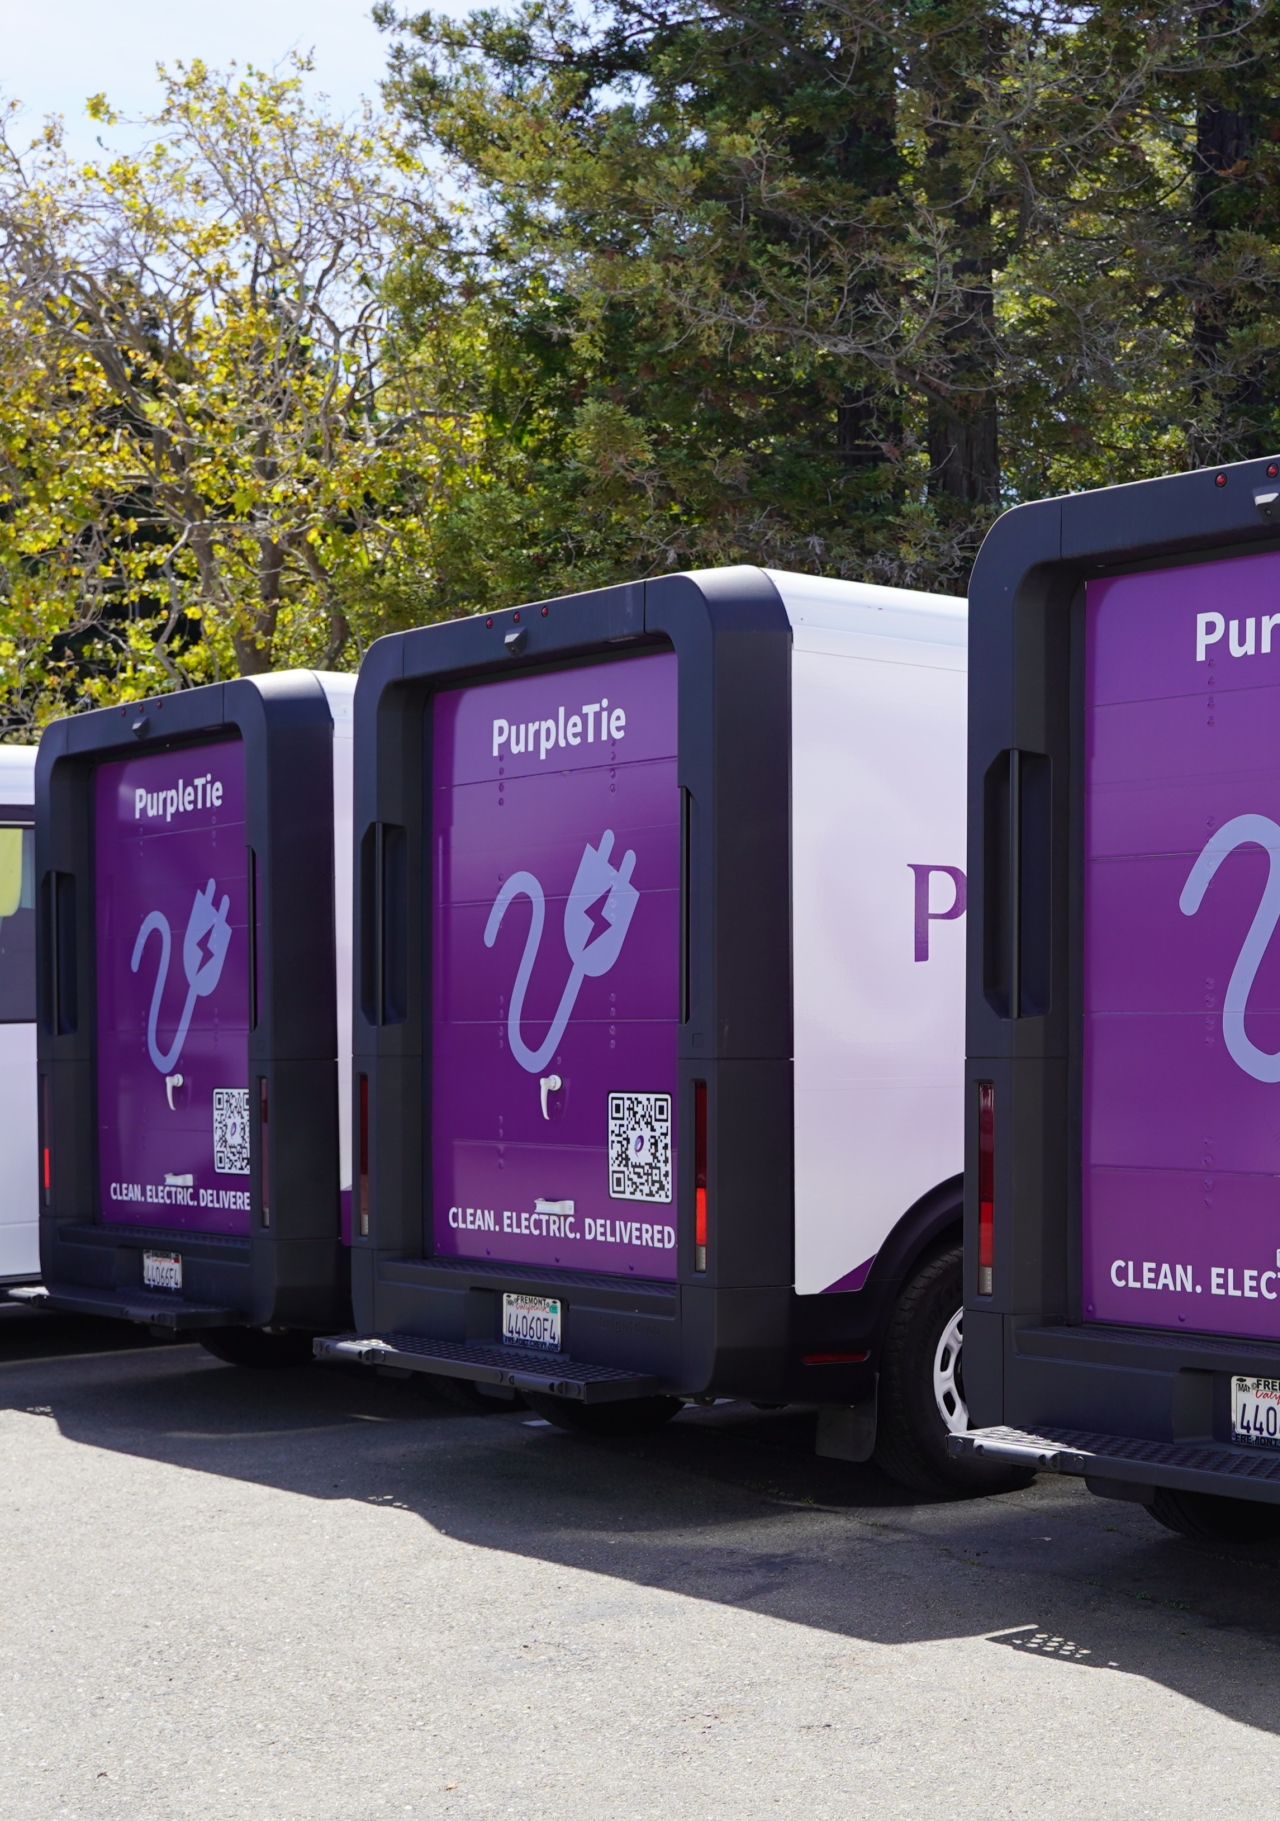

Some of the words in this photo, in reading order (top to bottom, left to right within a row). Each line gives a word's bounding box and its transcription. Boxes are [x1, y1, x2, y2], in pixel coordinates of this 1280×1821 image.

[492, 698, 626, 760] PurpleTie
[135, 773, 223, 822] PurpleTie
[109, 1182, 145, 1202] CLEAN.
[145, 1184, 198, 1206] ELECTRIC.
[448, 1206, 500, 1232] CLEAN.
[503, 1211, 581, 1240] ELECTRIC.
[1110, 1259, 1202, 1294] CLEAN.
[508, 1312, 556, 1343] 44060F4
